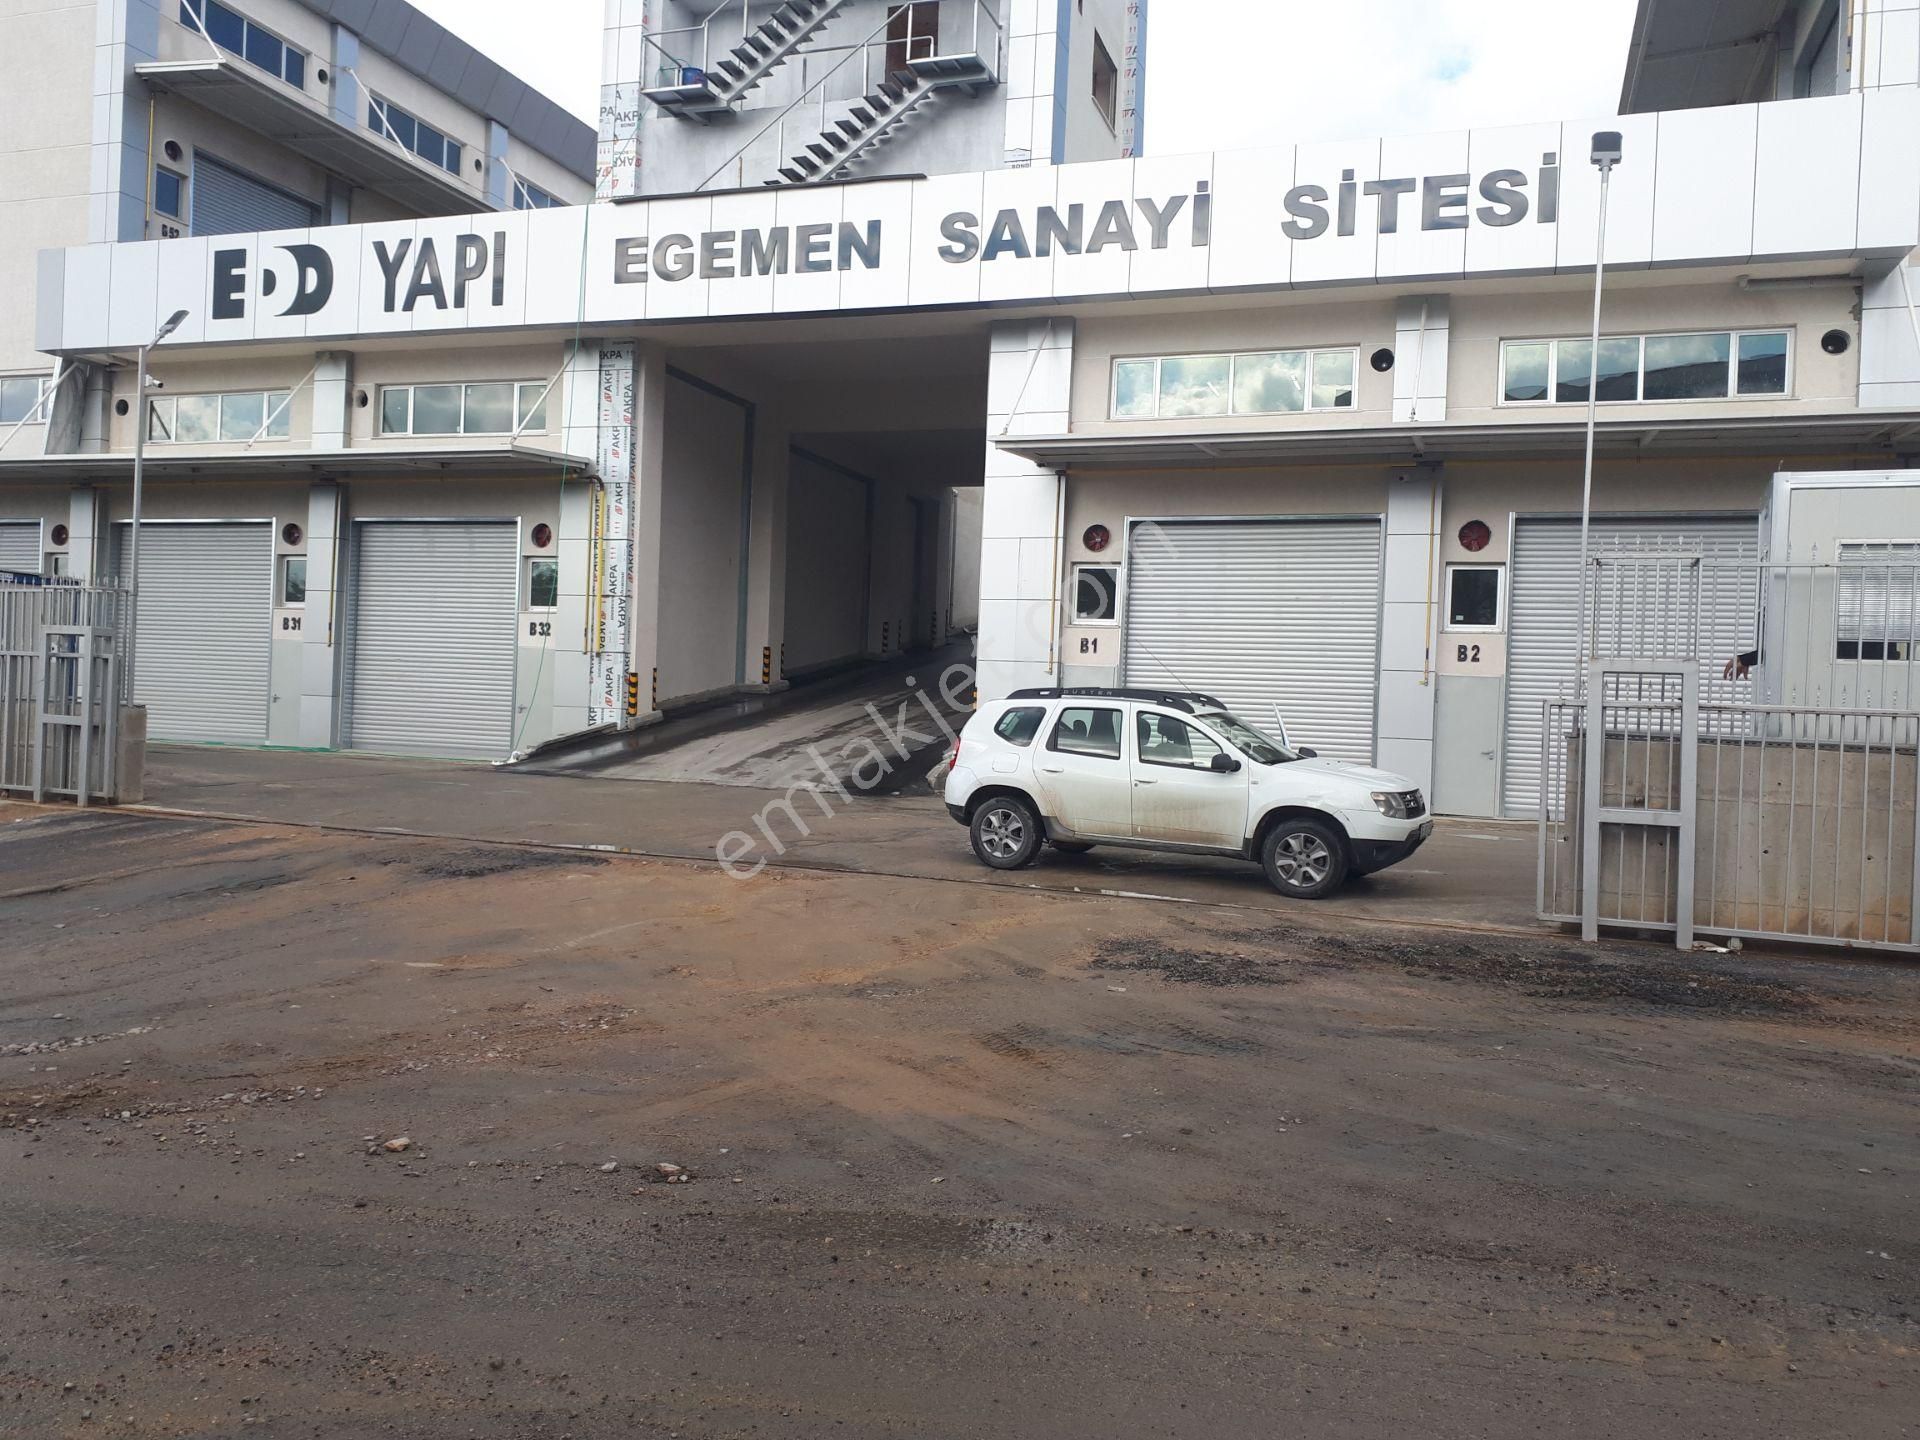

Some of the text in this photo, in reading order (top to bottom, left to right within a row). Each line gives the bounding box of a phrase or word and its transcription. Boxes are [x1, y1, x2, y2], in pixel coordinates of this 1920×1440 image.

[372, 231, 506, 313] YAPI
[614, 219, 881, 284] EGEMEN
[937, 180, 1210, 264] SANAYİ
[1281, 152, 1558, 240] SİTESİ
